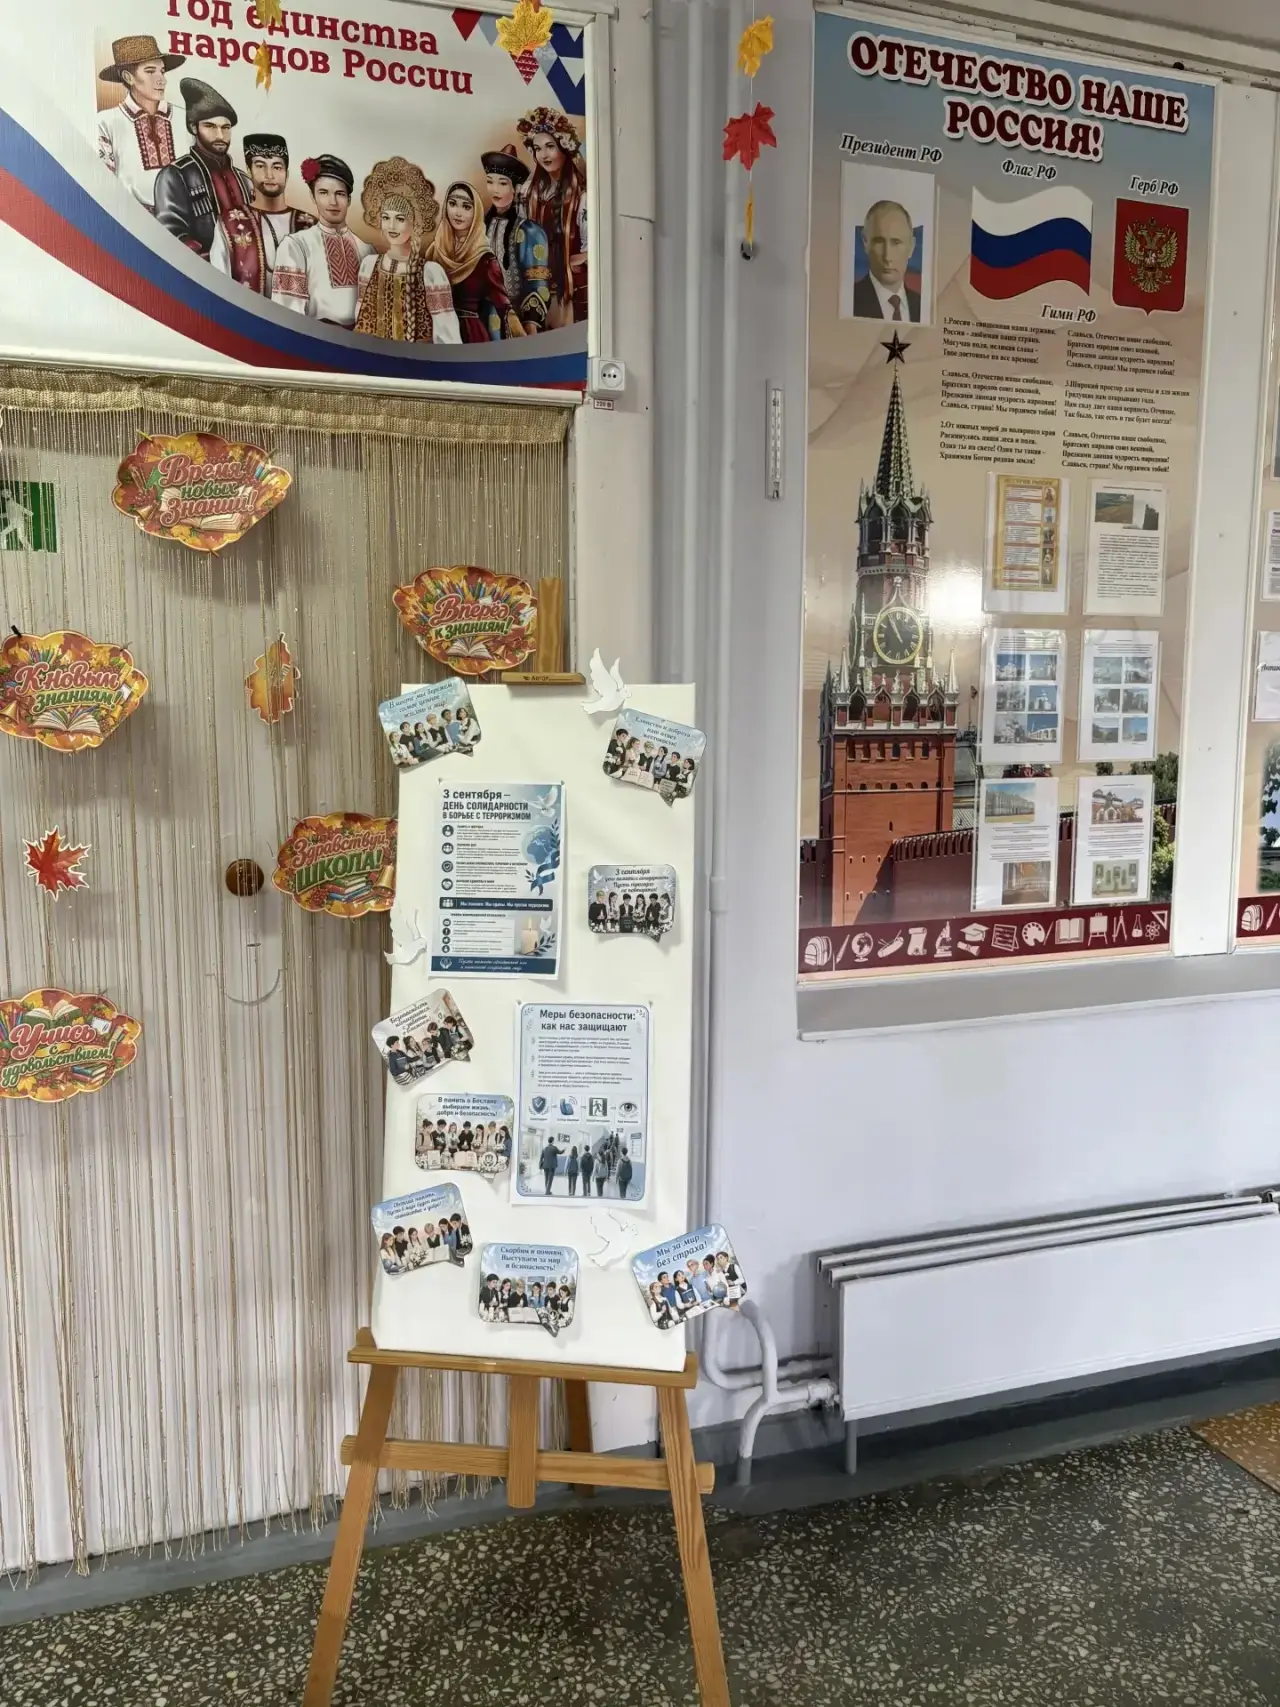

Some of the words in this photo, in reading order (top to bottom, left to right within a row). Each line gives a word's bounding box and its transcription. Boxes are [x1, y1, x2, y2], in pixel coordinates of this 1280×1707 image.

[168, 30, 330, 74] народов
[343, 49, 473, 94] России
[851, 36, 1071, 106] ОТЕЧЕСТВО
[1081, 79, 1186, 128] НАШЕ
[947, 100, 1102, 157] РОССИЯ!
[841, 135, 917, 161] Президент
[920, 146, 942, 163] РФ
[1003, 160, 1033, 178] Флаг
[1036, 164, 1057, 180] РФ
[1130, 177, 1158, 193] Герб
[1160, 180, 1179, 195] РФ
[1041, 305, 1075, 322] Гимн
[1077, 308, 1096, 323] РФ
[181, 480, 239, 499] новых
[160, 490, 258, 527] Знаний!
[429, 594, 510, 626] Вперёд
[445, 617, 514, 640] знаниям!
[15, 661, 49, 695] К
[44, 661, 120, 691] новым
[31, 689, 124, 714] знаниям!
[442, 802, 464, 811] ДЕНЬ
[467, 802, 528, 811] СОЛИДАРНОСТИ
[443, 789, 449, 799] 3
[453, 790, 502, 801] сентября
[482, 812, 531, 820] ТЕРРОРИЗМОМ
[296, 847, 383, 894] ШКОЛА!
[540, 1010, 566, 1020] Меры
[569, 1010, 636, 1020] безопасности:
[560, 1023, 575, 1031] нас
[578, 1023, 627, 1032] защищают
[9, 1023, 97, 1060] Учись
[49, 1045, 59, 1055] с
[1, 1040, 117, 1087] удовольствием!
[656, 1247, 670, 1257] Мы
[672, 1243, 681, 1251] за
[682, 1235, 700, 1247] мир
[657, 1258, 671, 1268] без
[672, 1241, 708, 1262] страха!
[511, 1263, 556, 1271] безопасность!
